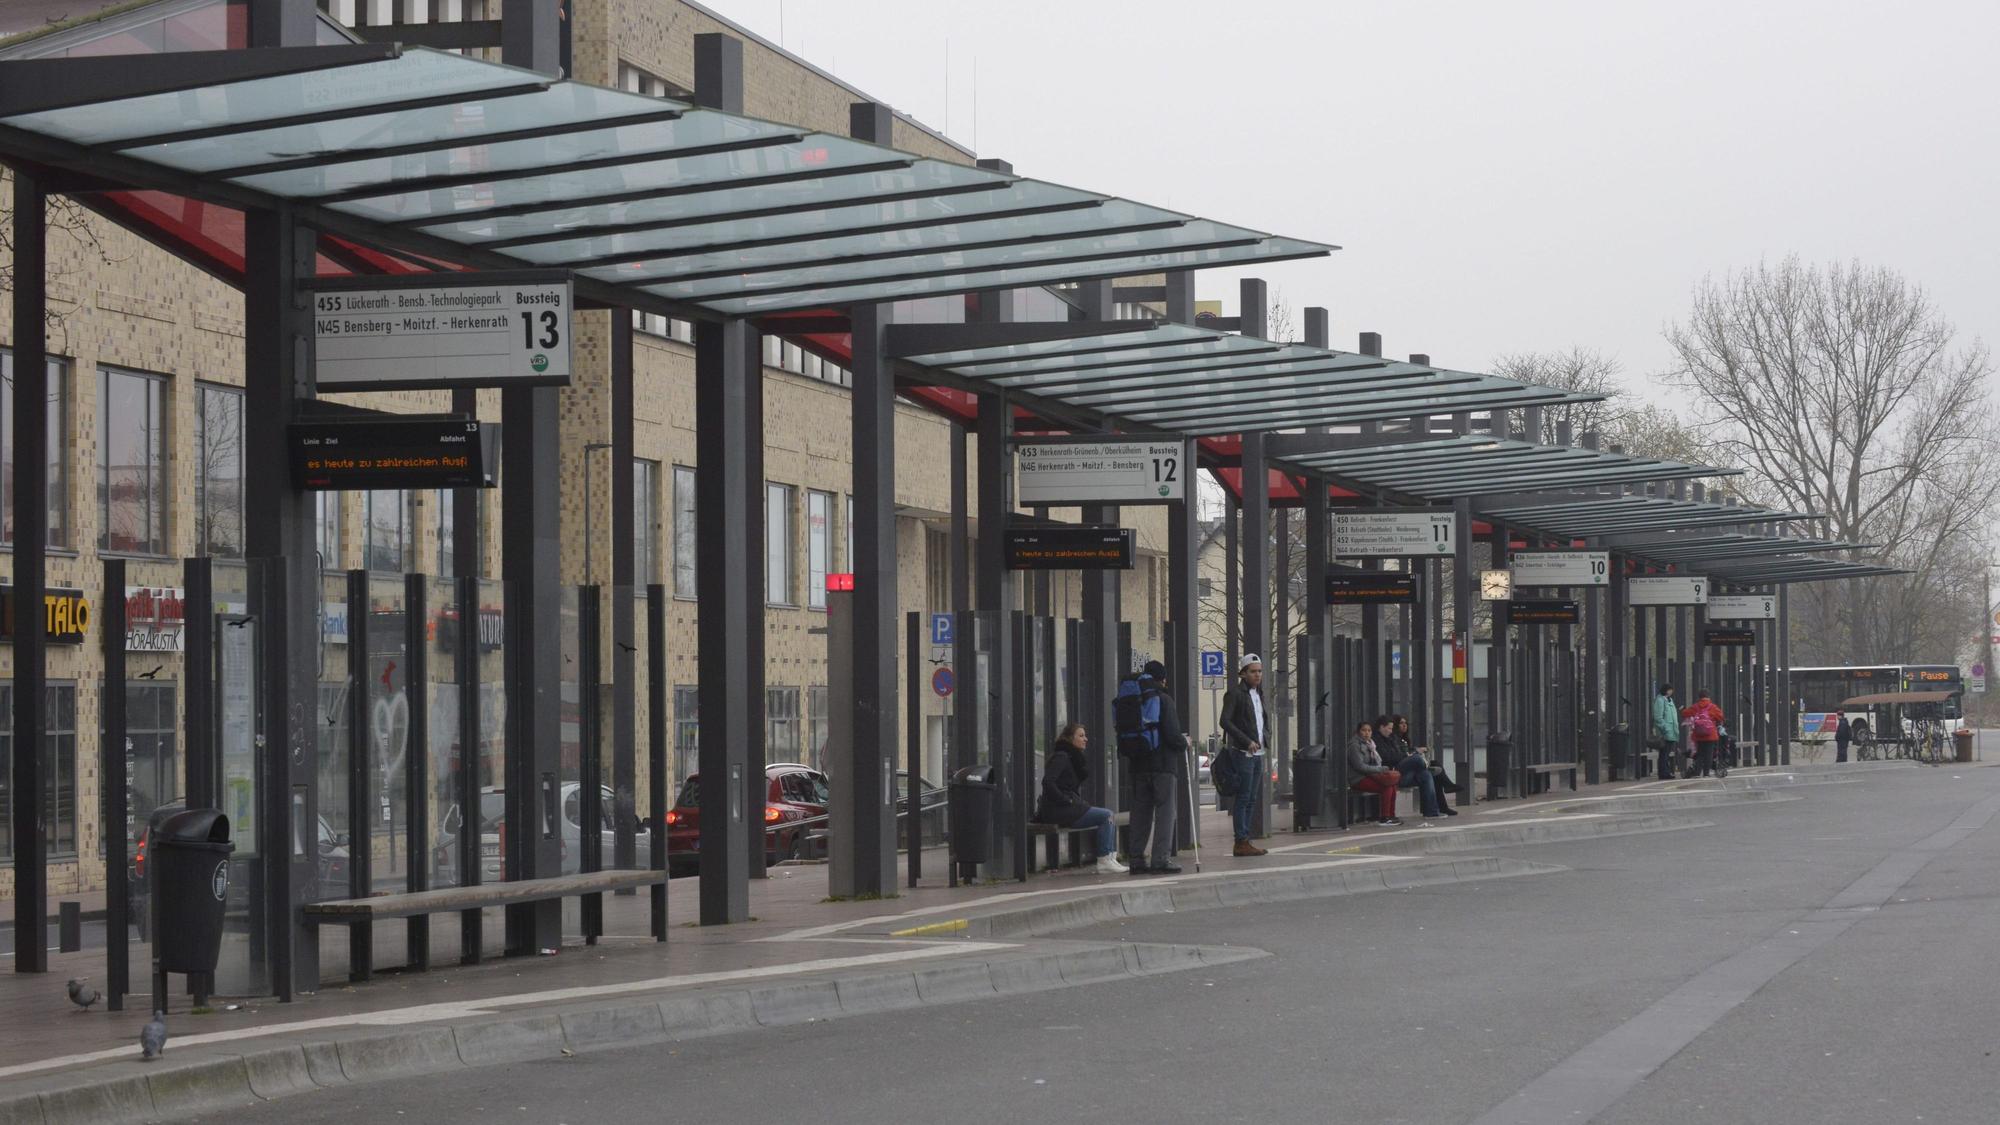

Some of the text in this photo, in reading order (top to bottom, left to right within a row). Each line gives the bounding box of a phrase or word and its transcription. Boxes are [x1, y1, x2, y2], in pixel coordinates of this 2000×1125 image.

[318, 297, 342, 311] 455
[347, 295, 389, 310] Lückerath
[399, 291, 501, 308] Bensb.-Technologiepark
[516, 291, 560, 306] Bussteig
[318, 320, 340, 334] N45
[345, 320, 391, 334] Bensberg
[404, 318, 439, 330] Moitzf.
[451, 315, 508, 329] Herkenrath
[521, 310, 560, 349] 13
[1021, 448, 1037, 457] 453
[1149, 447, 1178, 456] Bussteig
[325, 459, 354, 468] heute
[359, 459, 372, 468] zu
[376, 457, 438, 467] zahlreichen
[1038, 461, 1075, 471] Herkenrath
[1113, 461, 1144, 470] Bensberg
[1152, 458, 1177, 482] 12
[1433, 525, 1448, 542] 11
[1590, 561, 1605, 575] 10
[1694, 584, 1701, 595] 9
[1765, 602, 1771, 612] 8
[937, 618, 949, 640] P
[1206, 655, 1219, 672] P
[1920, 672, 1949, 680] Pause
